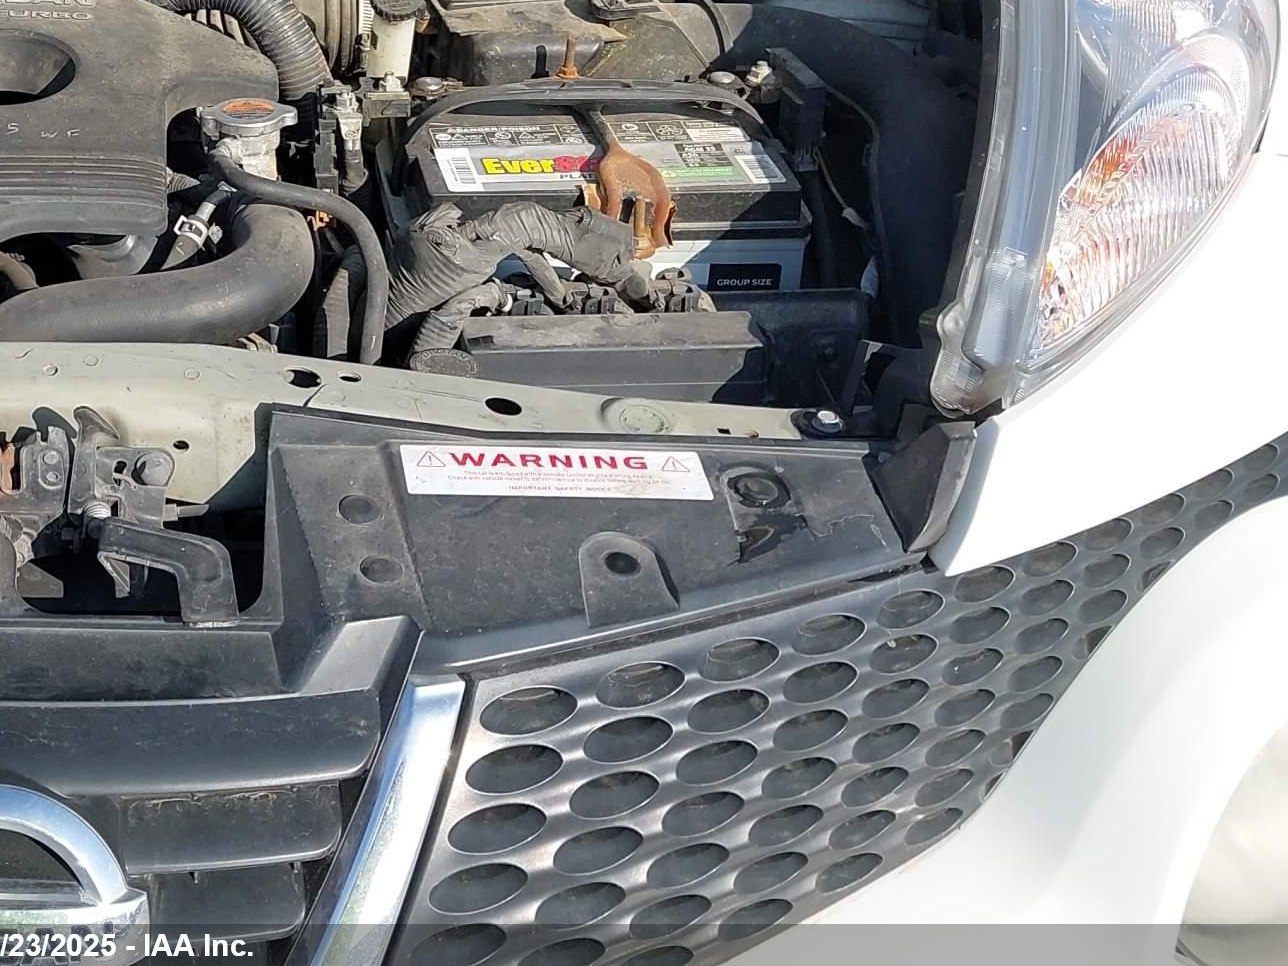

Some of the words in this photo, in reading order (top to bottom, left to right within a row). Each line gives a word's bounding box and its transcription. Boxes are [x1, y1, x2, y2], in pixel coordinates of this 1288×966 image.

[716, 278, 751, 286] GROUP
[751, 278, 773, 286] SIZE
[448, 451, 649, 470] WARNING
